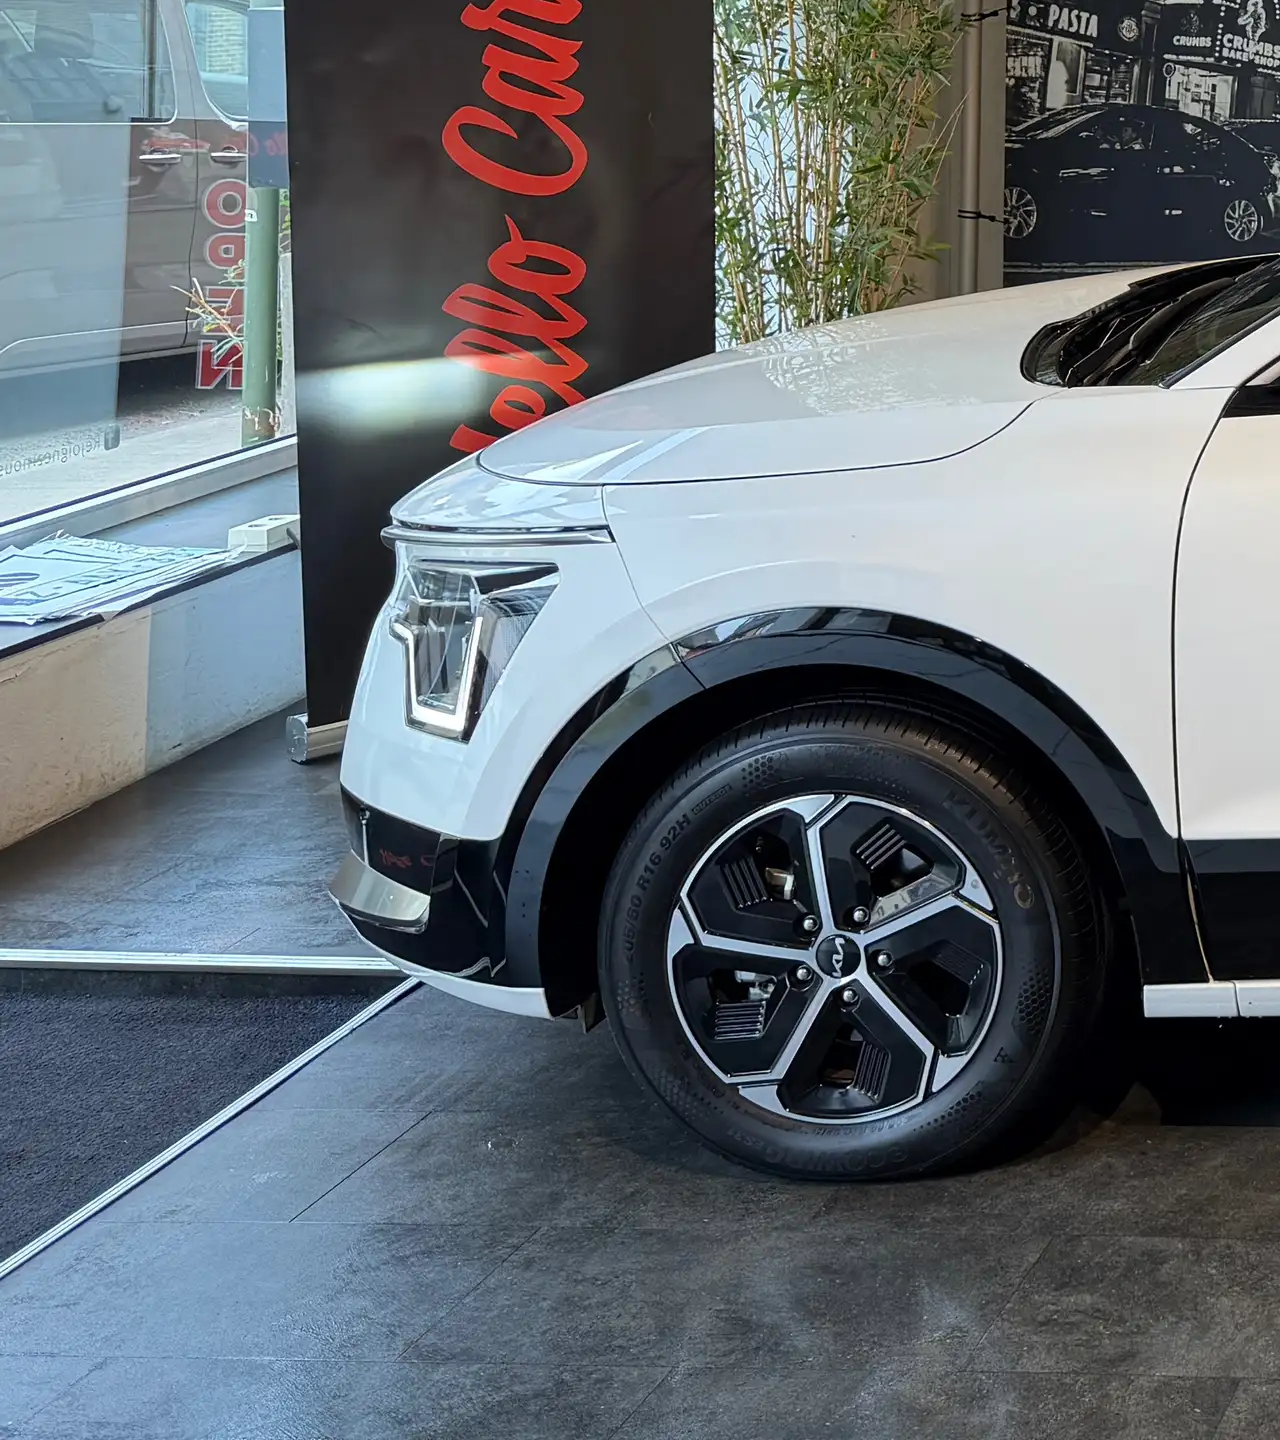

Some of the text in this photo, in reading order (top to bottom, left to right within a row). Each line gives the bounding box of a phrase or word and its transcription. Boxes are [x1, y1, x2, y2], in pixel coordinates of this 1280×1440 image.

[1047, 3, 1099, 39] PASTA
[441, 213, 590, 453] ello
[659, 812, 693, 851] 92H
